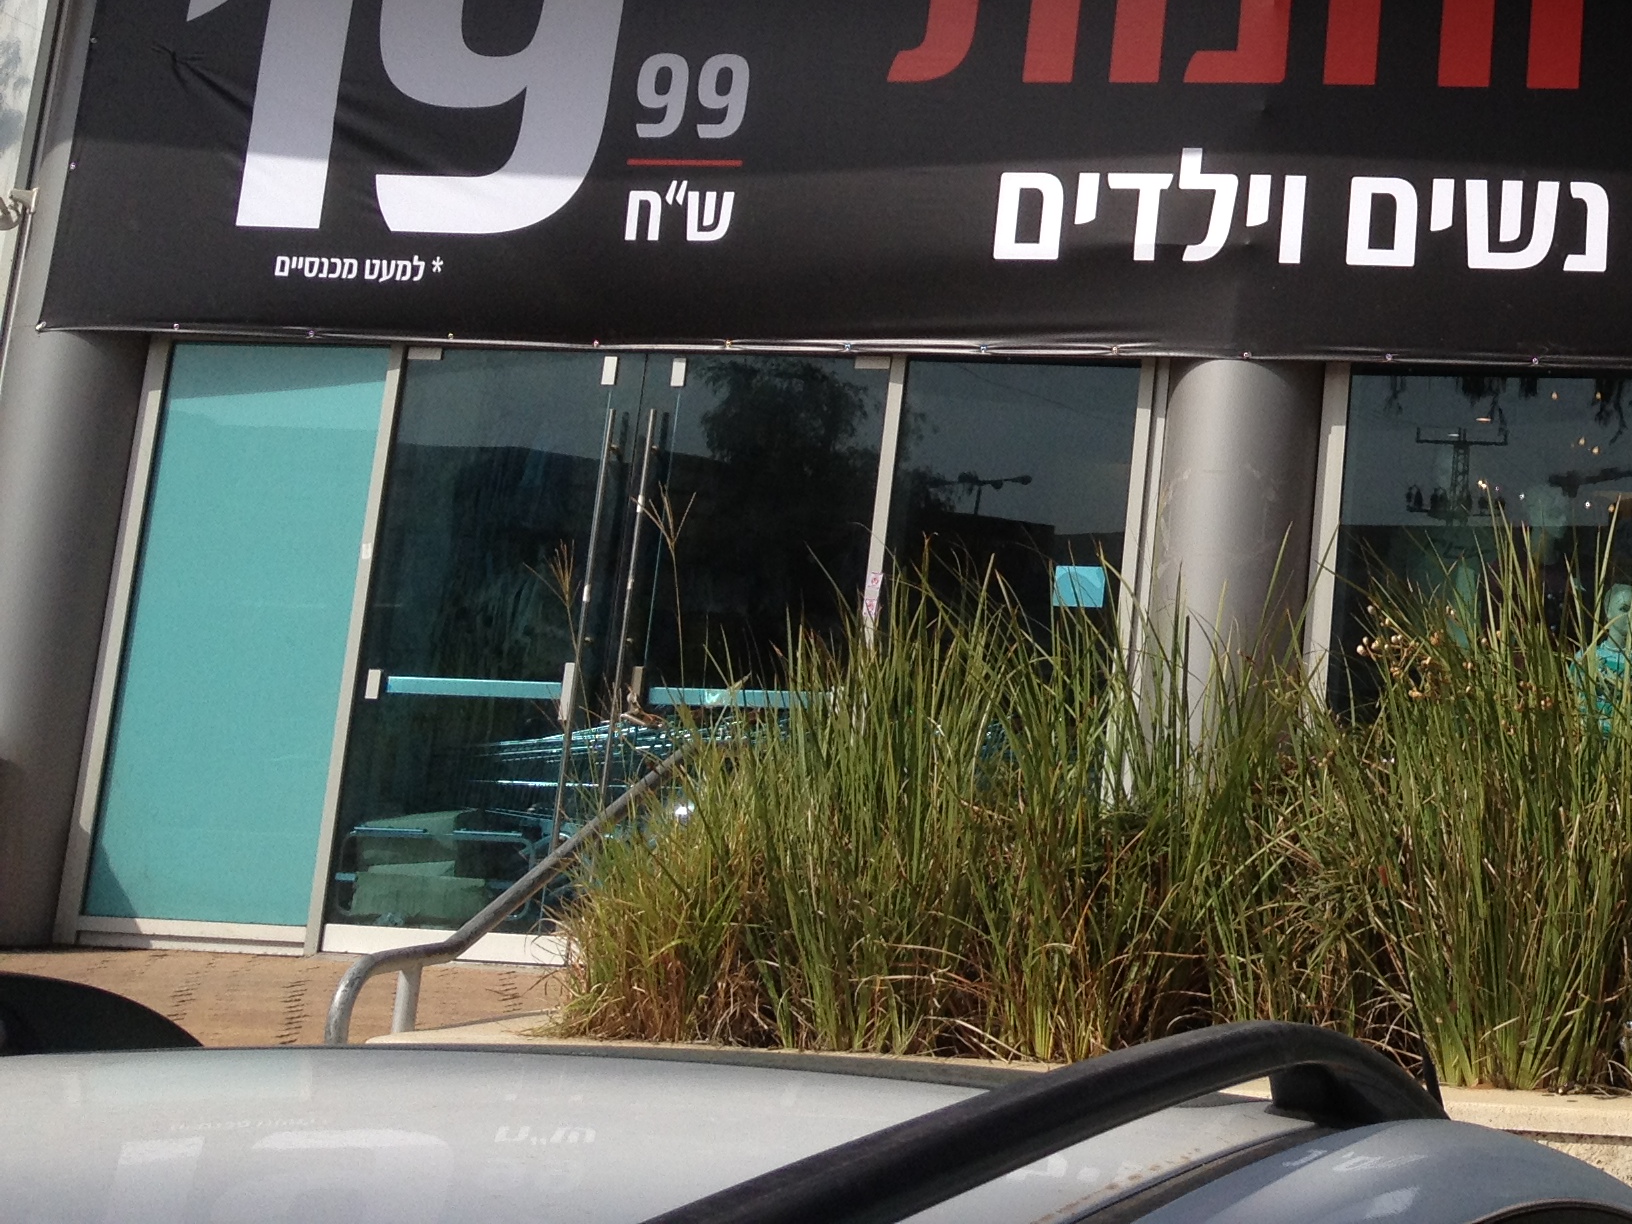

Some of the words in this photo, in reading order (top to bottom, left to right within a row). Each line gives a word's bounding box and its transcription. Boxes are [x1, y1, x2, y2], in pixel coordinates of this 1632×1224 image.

[635, 52, 750, 140] 99
[992, 147, 1308, 265] וילדים
[1345, 176, 1610, 273] נשים
[274, 255, 358, 279] מכנסיים
